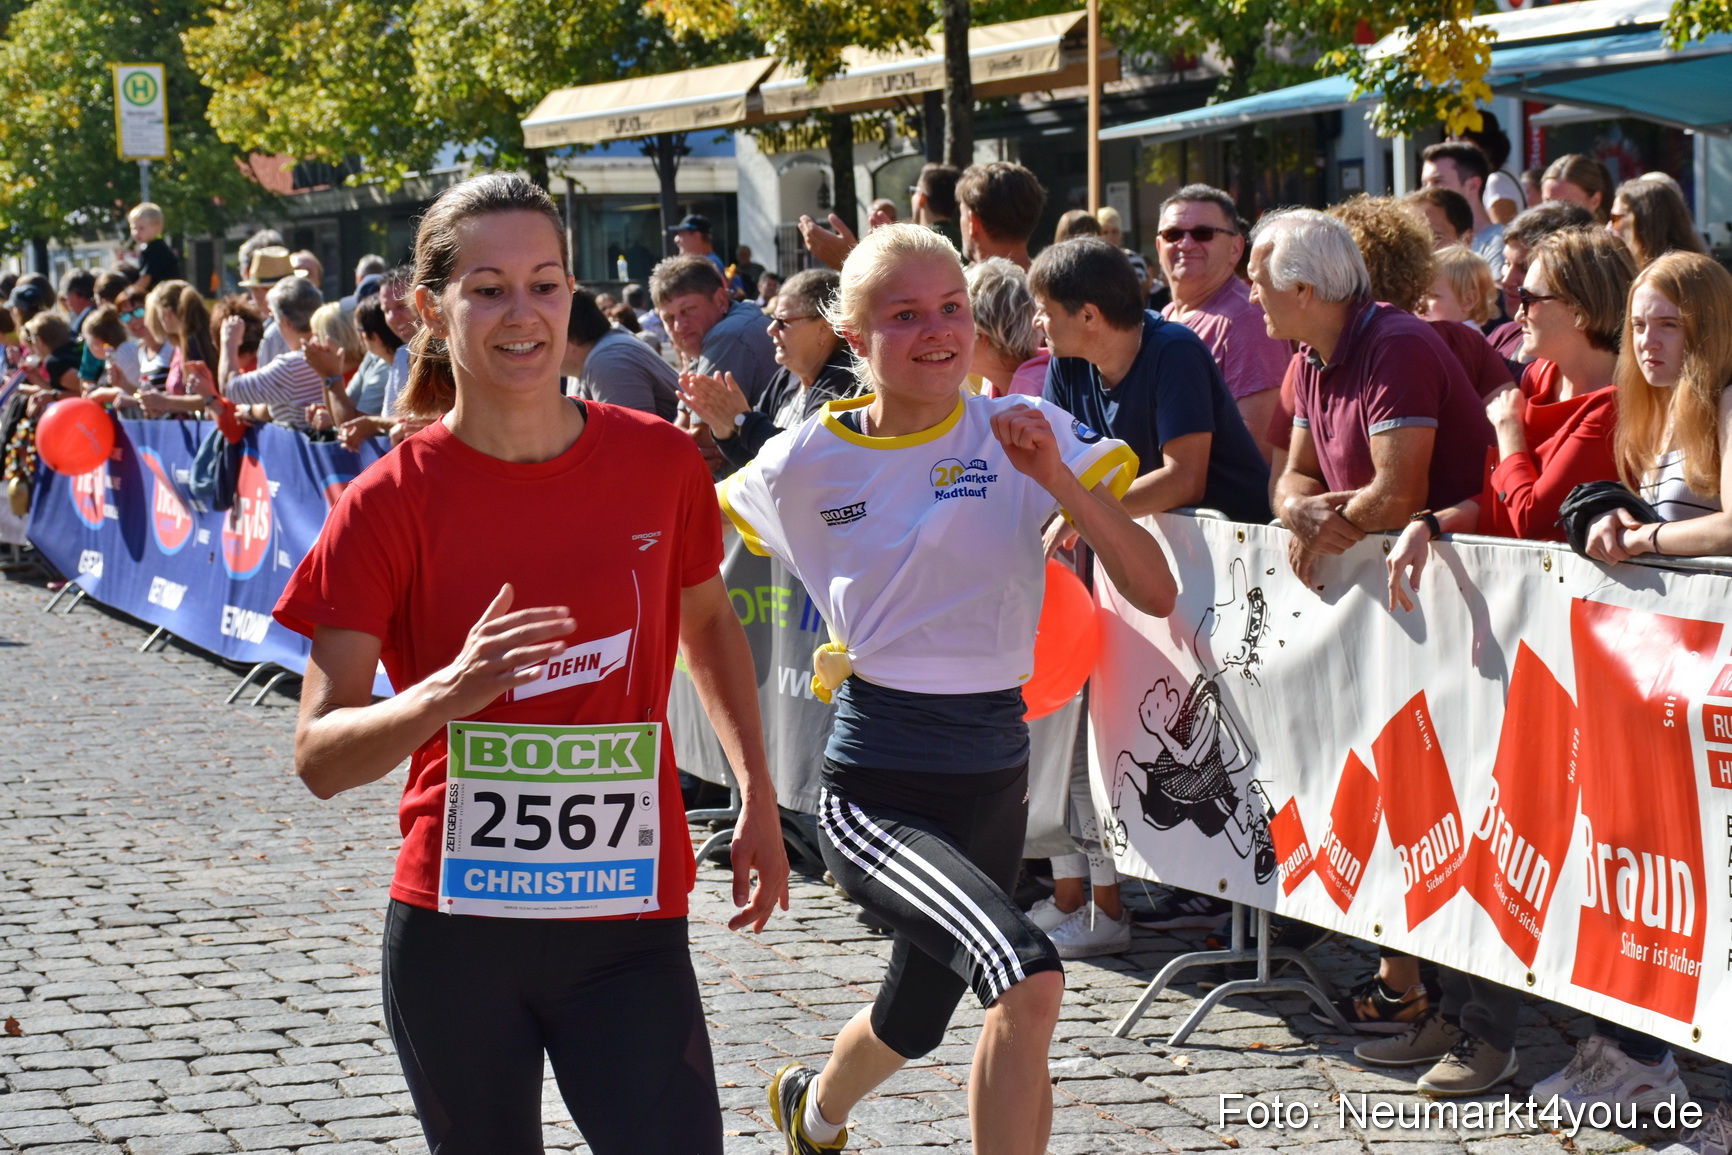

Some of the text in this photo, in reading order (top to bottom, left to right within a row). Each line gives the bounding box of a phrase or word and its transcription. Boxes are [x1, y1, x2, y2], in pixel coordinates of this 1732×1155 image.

[820, 501, 867, 522] BOCK
[547, 652, 602, 680] DEHN
[1663, 695, 1677, 727] Seit
[467, 732, 640, 774] BOCK
[1423, 733, 1432, 751] Seit
[1567, 760, 1578, 783] Seit
[471, 791, 635, 851] 2567
[1279, 842, 1309, 881] Braun
[1320, 815, 1361, 887] Braun
[1398, 812, 1461, 895] Braun
[1474, 774, 1551, 912] Braun
[464, 868, 636, 895] CHRISTINE
[1426, 873, 1445, 892] Sicher
[1444, 864, 1453, 878] ist
[1493, 873, 1508, 906] Sicher
[1507, 897, 1519, 918] ist
[1580, 813, 1696, 938] Braun
[1620, 932, 1702, 977] Sicher ist sicher
